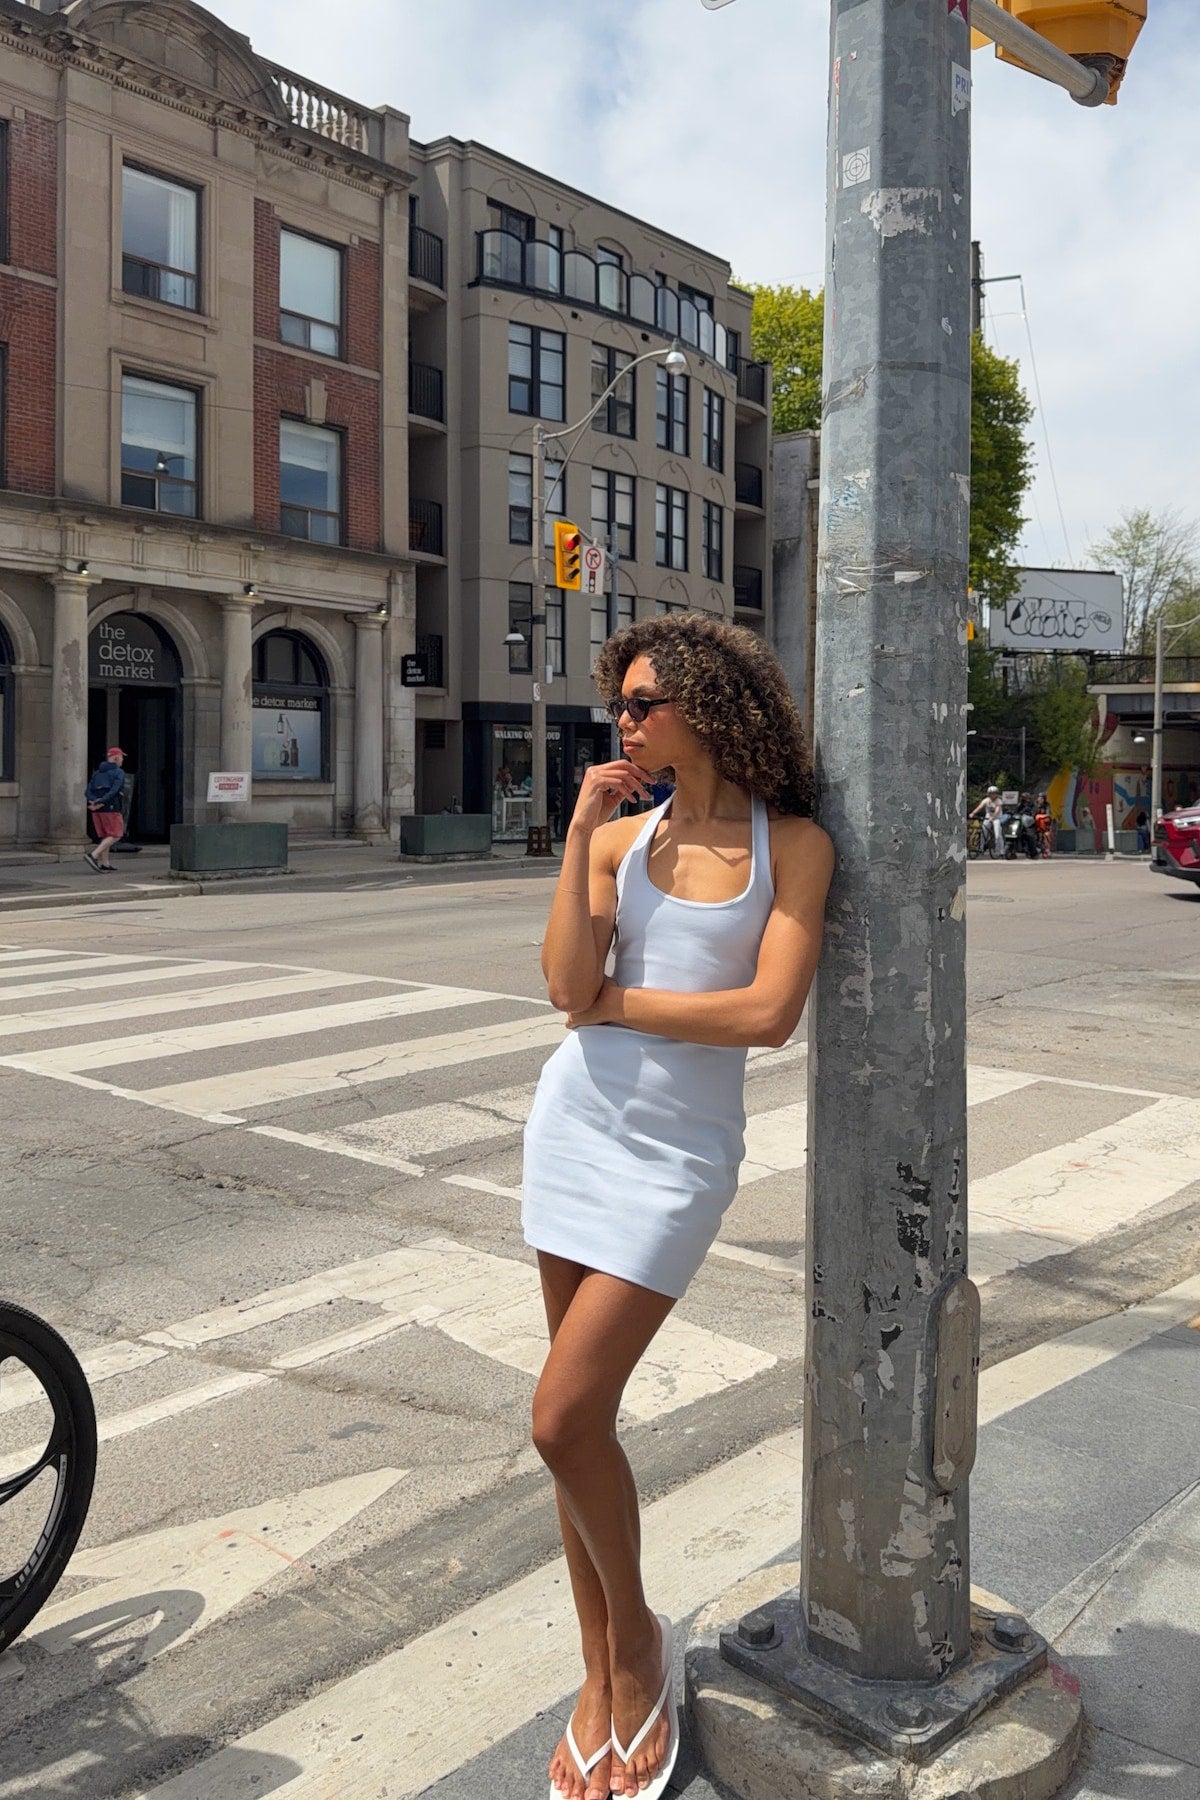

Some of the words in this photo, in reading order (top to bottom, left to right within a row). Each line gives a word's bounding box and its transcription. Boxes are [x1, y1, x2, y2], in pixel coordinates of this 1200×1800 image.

[99, 622, 125, 640] the
[99, 640, 155, 663] detox
[99, 662, 155, 680] market
[260, 696, 286, 707] detox
[287, 698, 318, 709] market
[494, 730, 523, 740] WALKING
